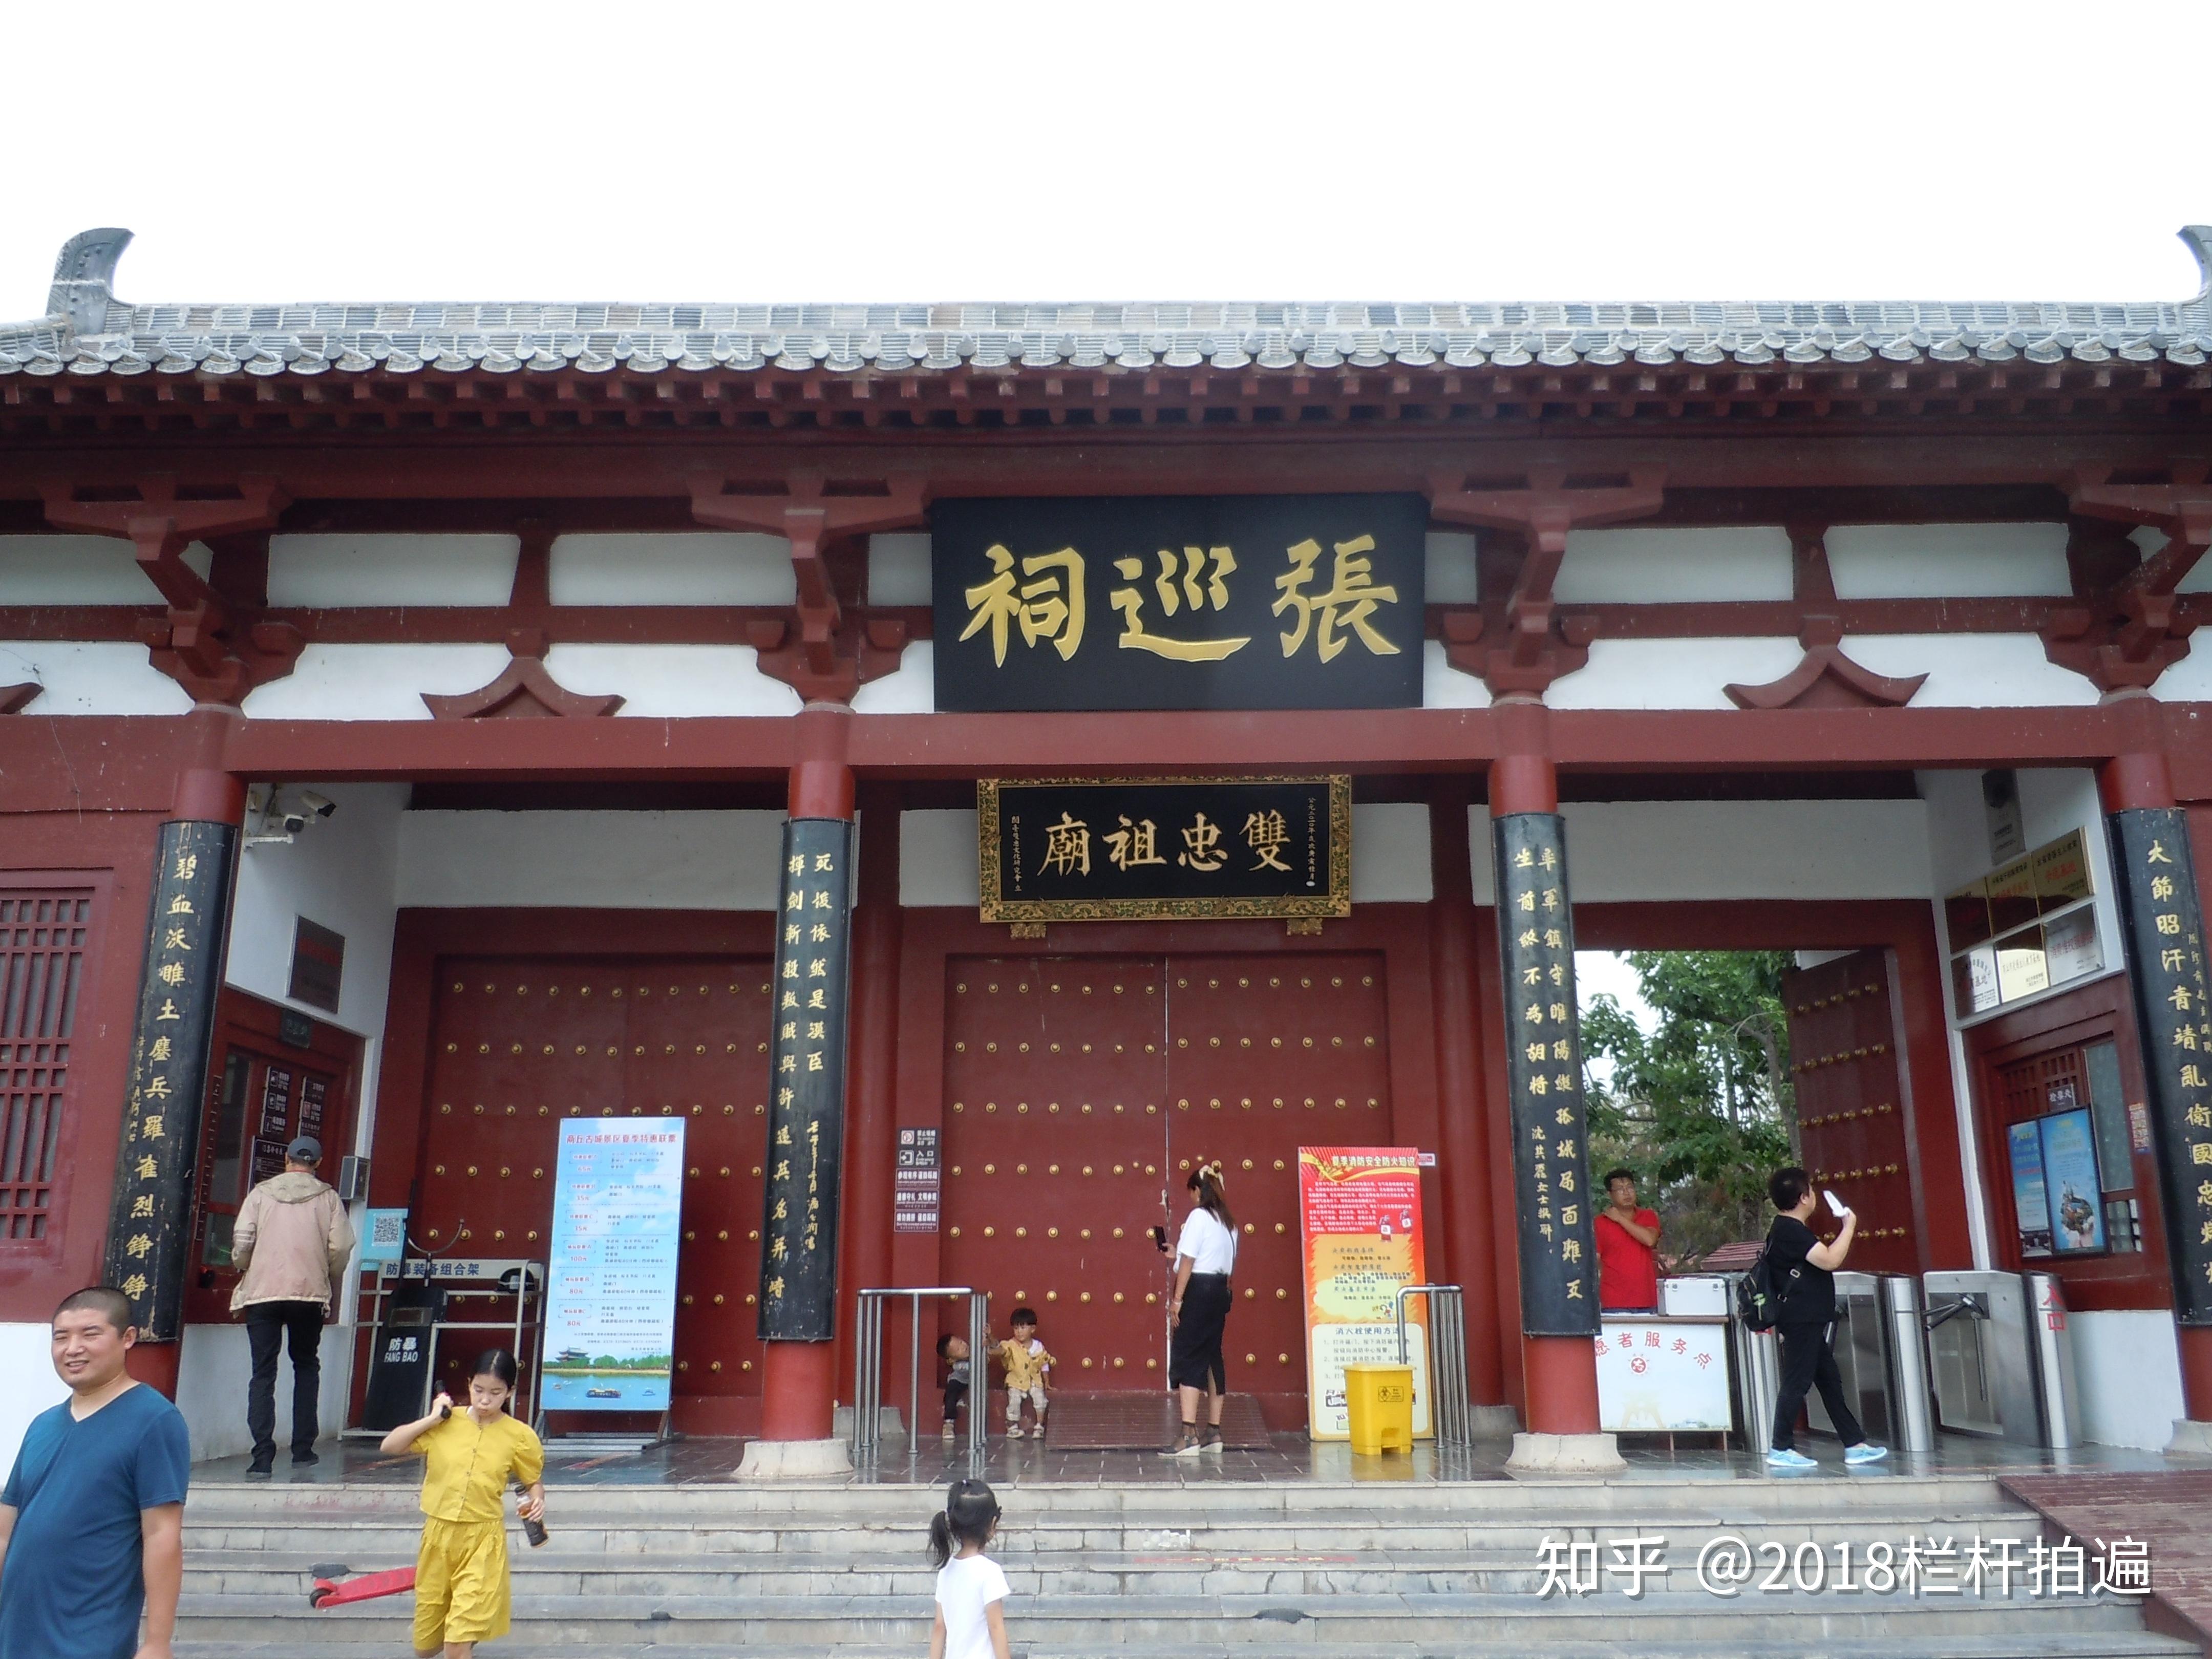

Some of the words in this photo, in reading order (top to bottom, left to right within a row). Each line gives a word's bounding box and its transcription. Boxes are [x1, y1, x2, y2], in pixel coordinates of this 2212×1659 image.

[959, 534, 1401, 668] 張巡祠
[1036, 809, 1294, 878] 雙忠祖廟
[2044, 1285, 2066, 1331] 入口
[384, 1352, 401, 1363] FANG
[402, 1351, 418, 1363] BAO
[389, 1337, 417, 1351] 防暴
